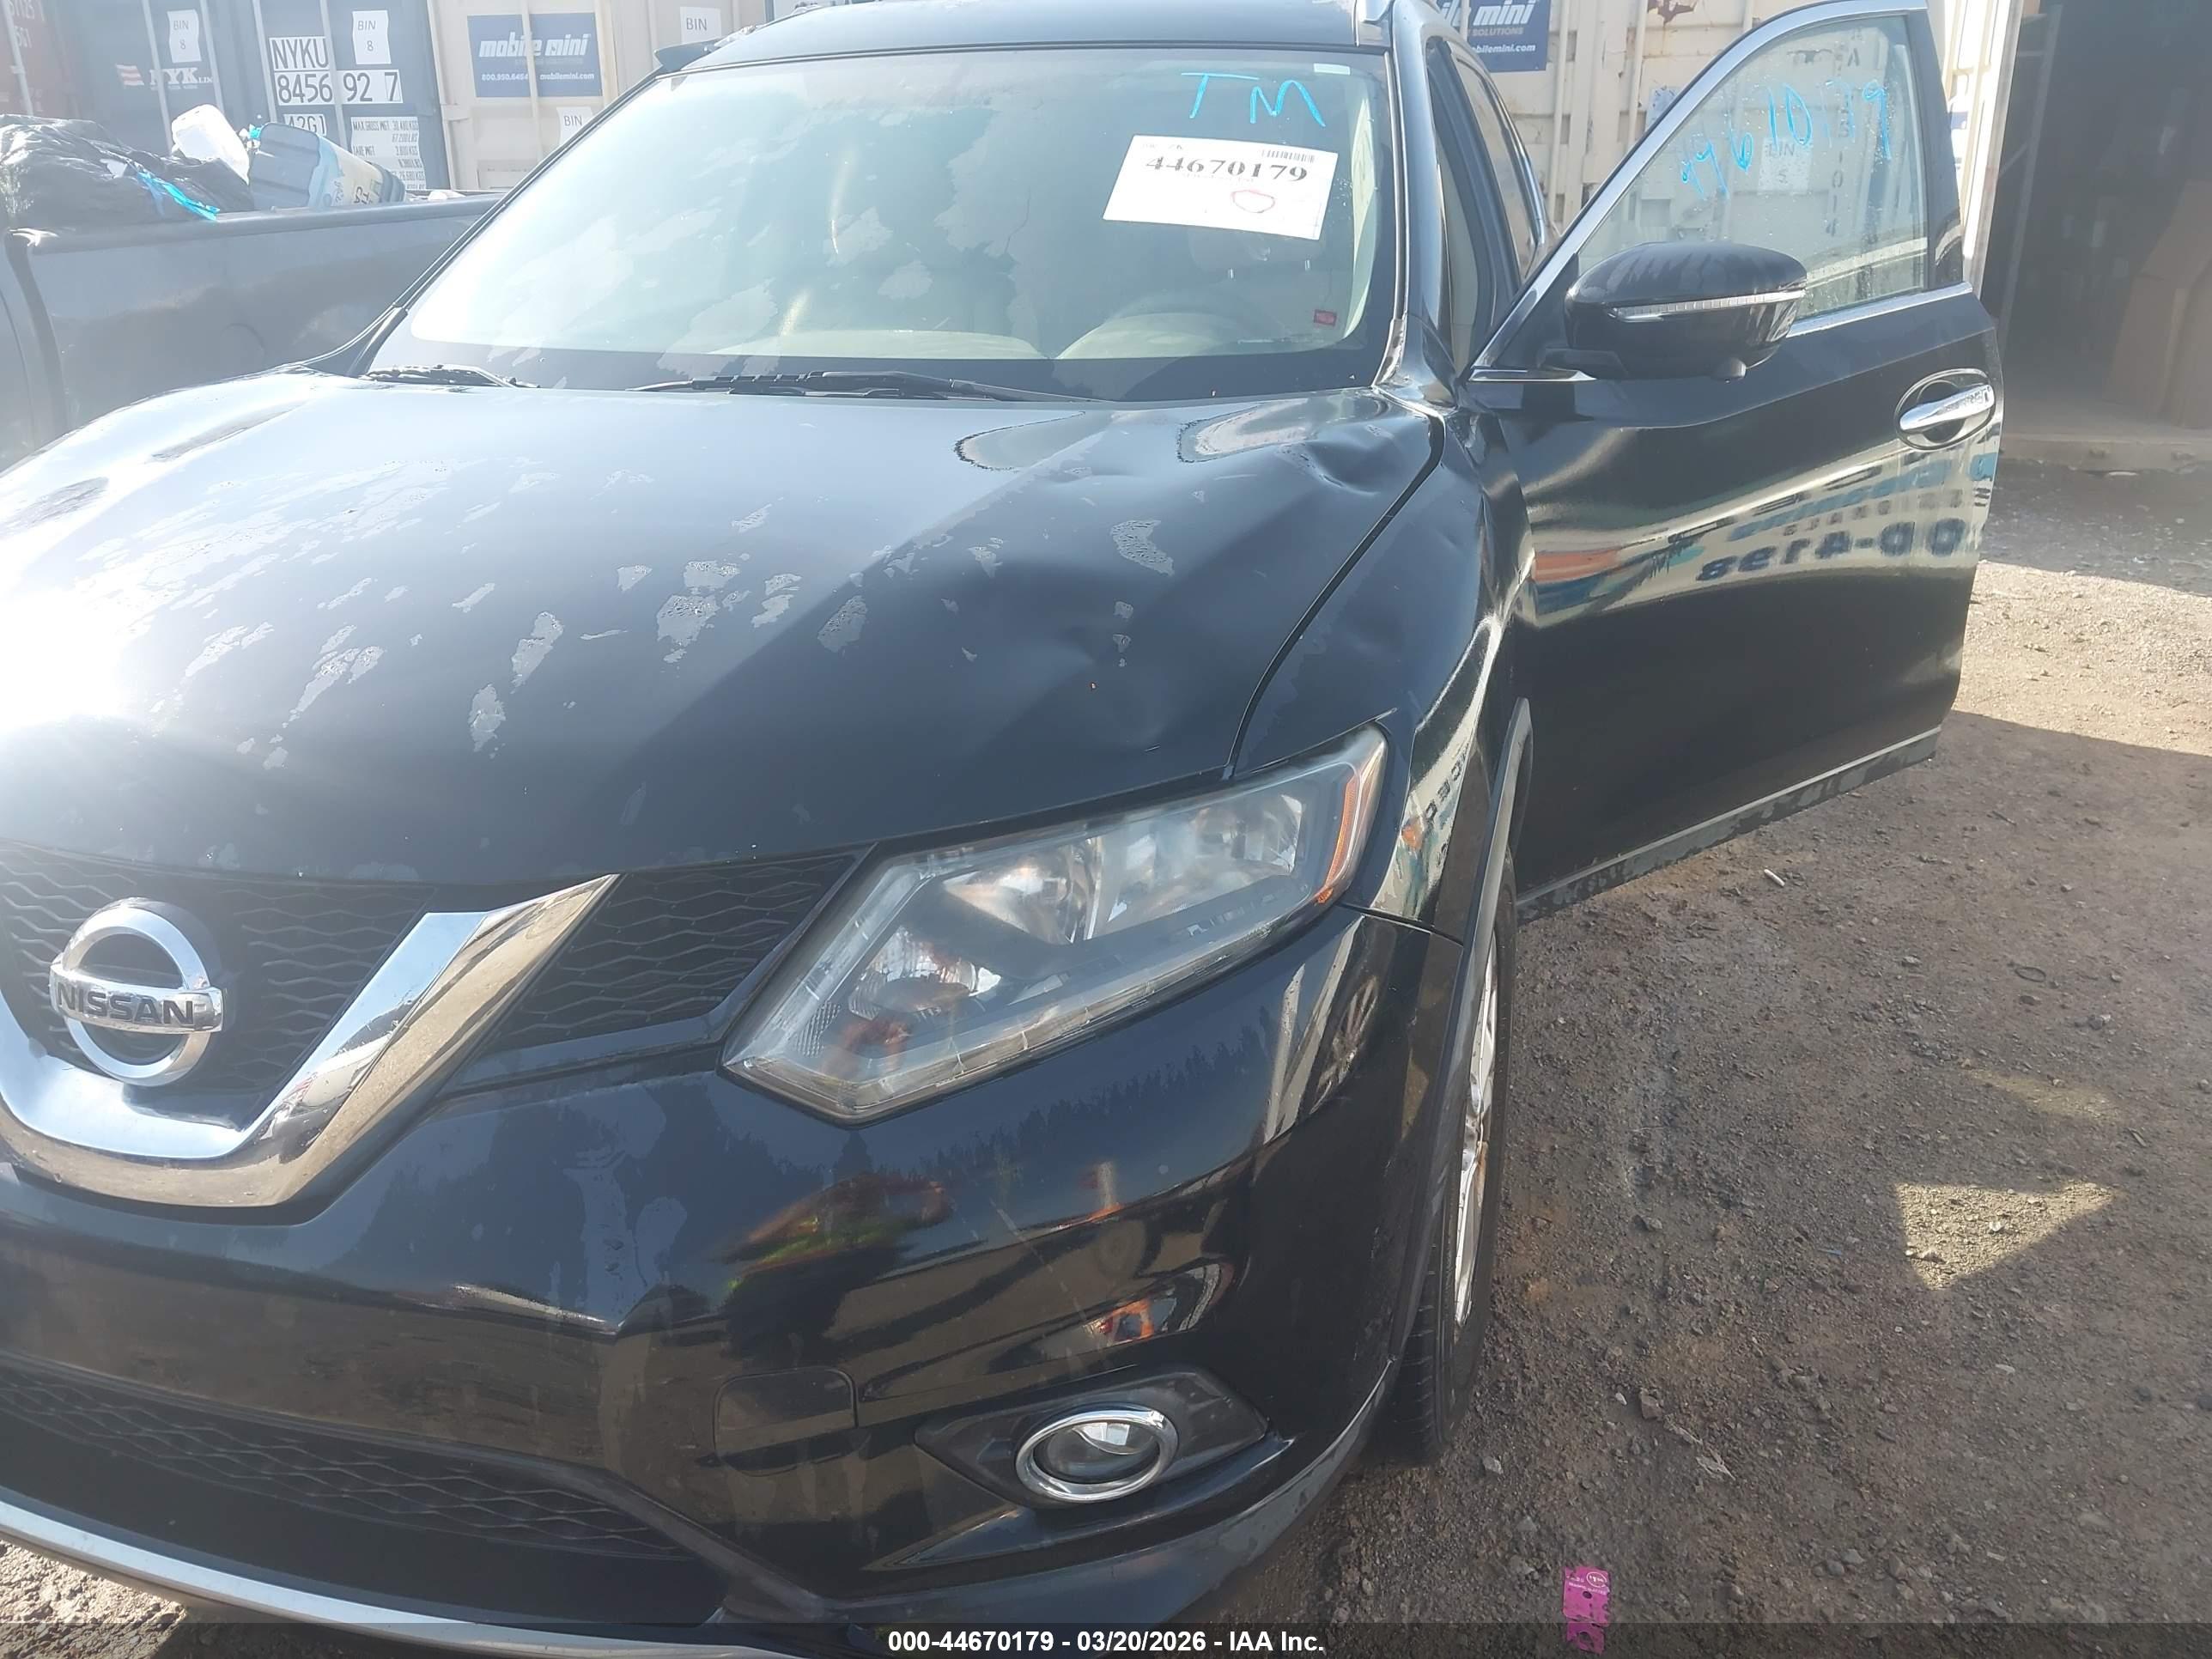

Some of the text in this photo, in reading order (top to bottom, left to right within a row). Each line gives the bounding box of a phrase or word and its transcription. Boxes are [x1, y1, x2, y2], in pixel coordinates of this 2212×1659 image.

[1473, 0, 1537, 26] mini
[173, 20, 189, 31] BIN
[357, 20, 376, 31] BIN
[686, 18, 708, 31] BIN
[179, 40, 186, 50] 8
[367, 40, 374, 52] 8
[544, 33, 591, 57] mini
[271, 38, 330, 70] NYKU
[539, 72, 595, 81] mobilemini.com
[277, 71, 398, 104] 8456 92 7
[563, 115, 583, 126] BIN
[1146, 156, 1308, 181] 44670179
[57, 983, 194, 1025] NISSAN
